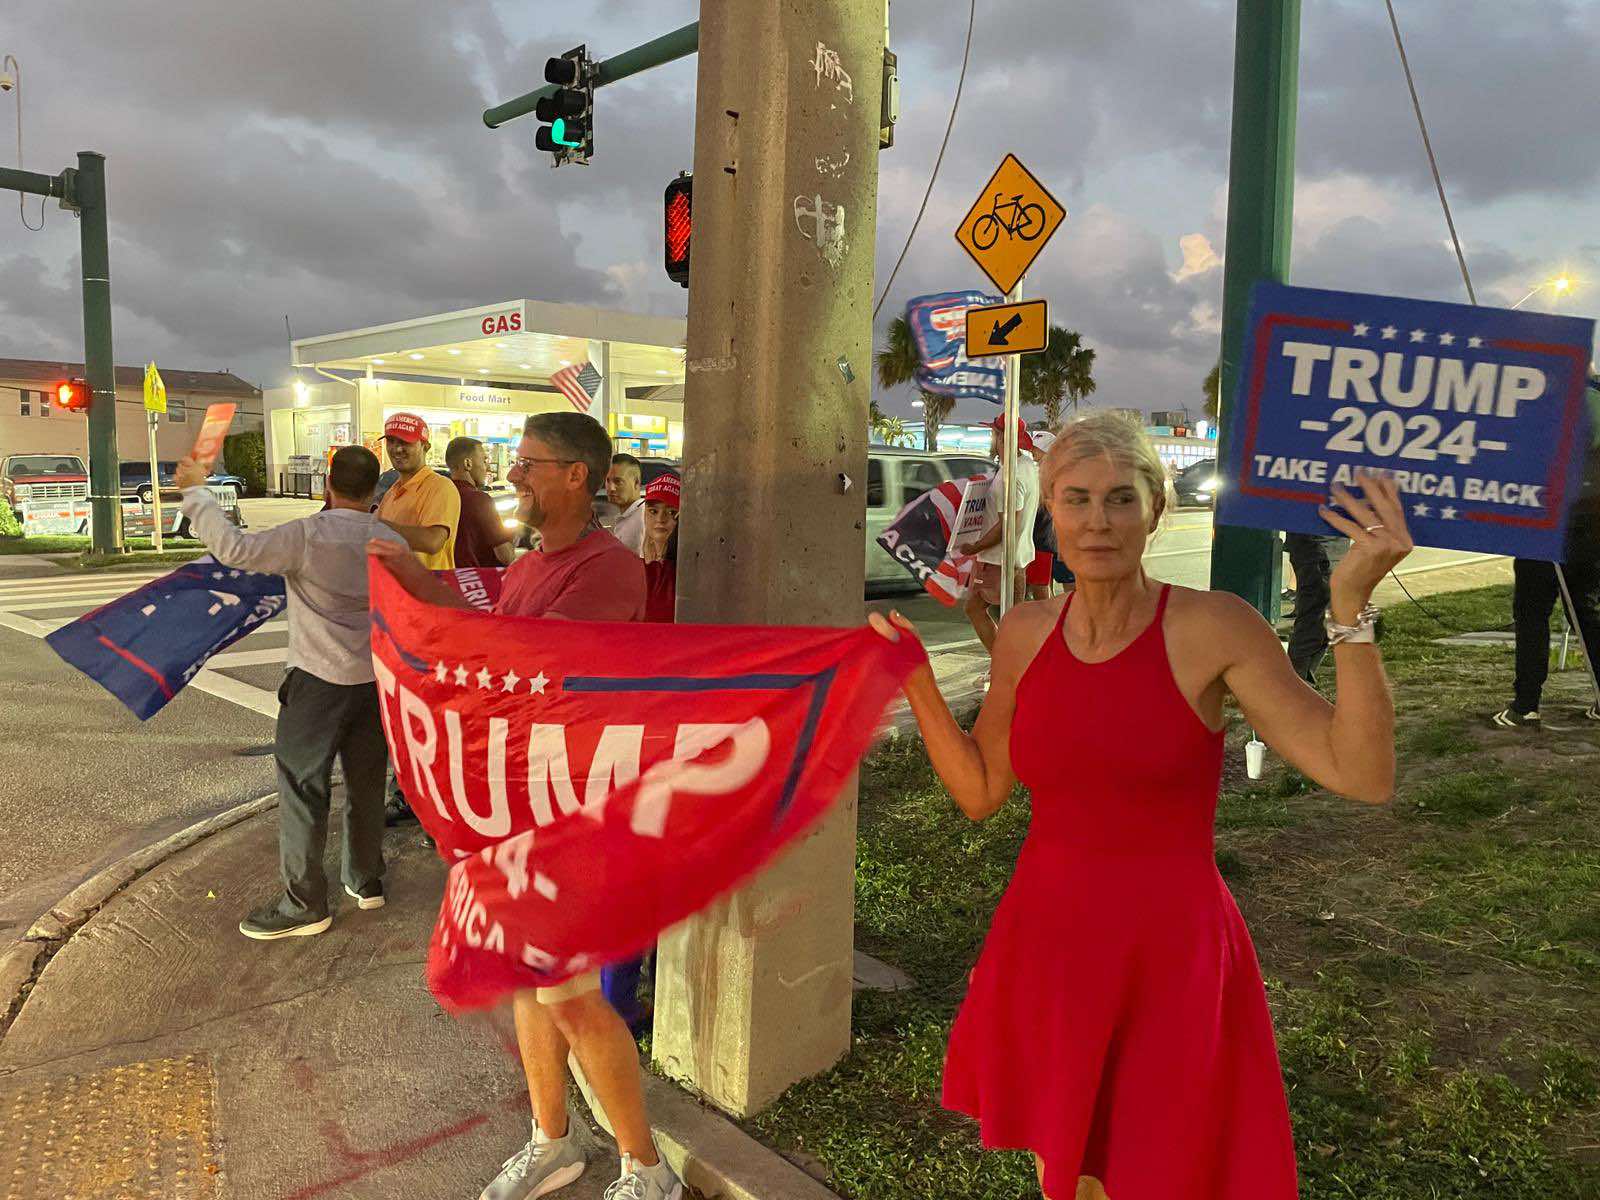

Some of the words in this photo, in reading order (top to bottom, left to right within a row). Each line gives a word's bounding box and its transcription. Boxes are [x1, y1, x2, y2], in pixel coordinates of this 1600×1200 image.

[481, 312, 522, 336] GAS
[460, 392, 484, 402] Food
[489, 394, 511, 404] Mart
[1281, 340, 1547, 418] TRUMP
[1300, 406, 1508, 465] -2024-
[964, 498, 987, 514] TRU
[1254, 454, 1329, 484] TAKE
[1331, 463, 1457, 498] ARICA
[1462, 477, 1545, 508] BACK
[963, 516, 984, 528] VANC
[879, 529, 934, 580] ACK
[371, 651, 771, 839] TRUMP
[449, 859, 505, 954] RICA
